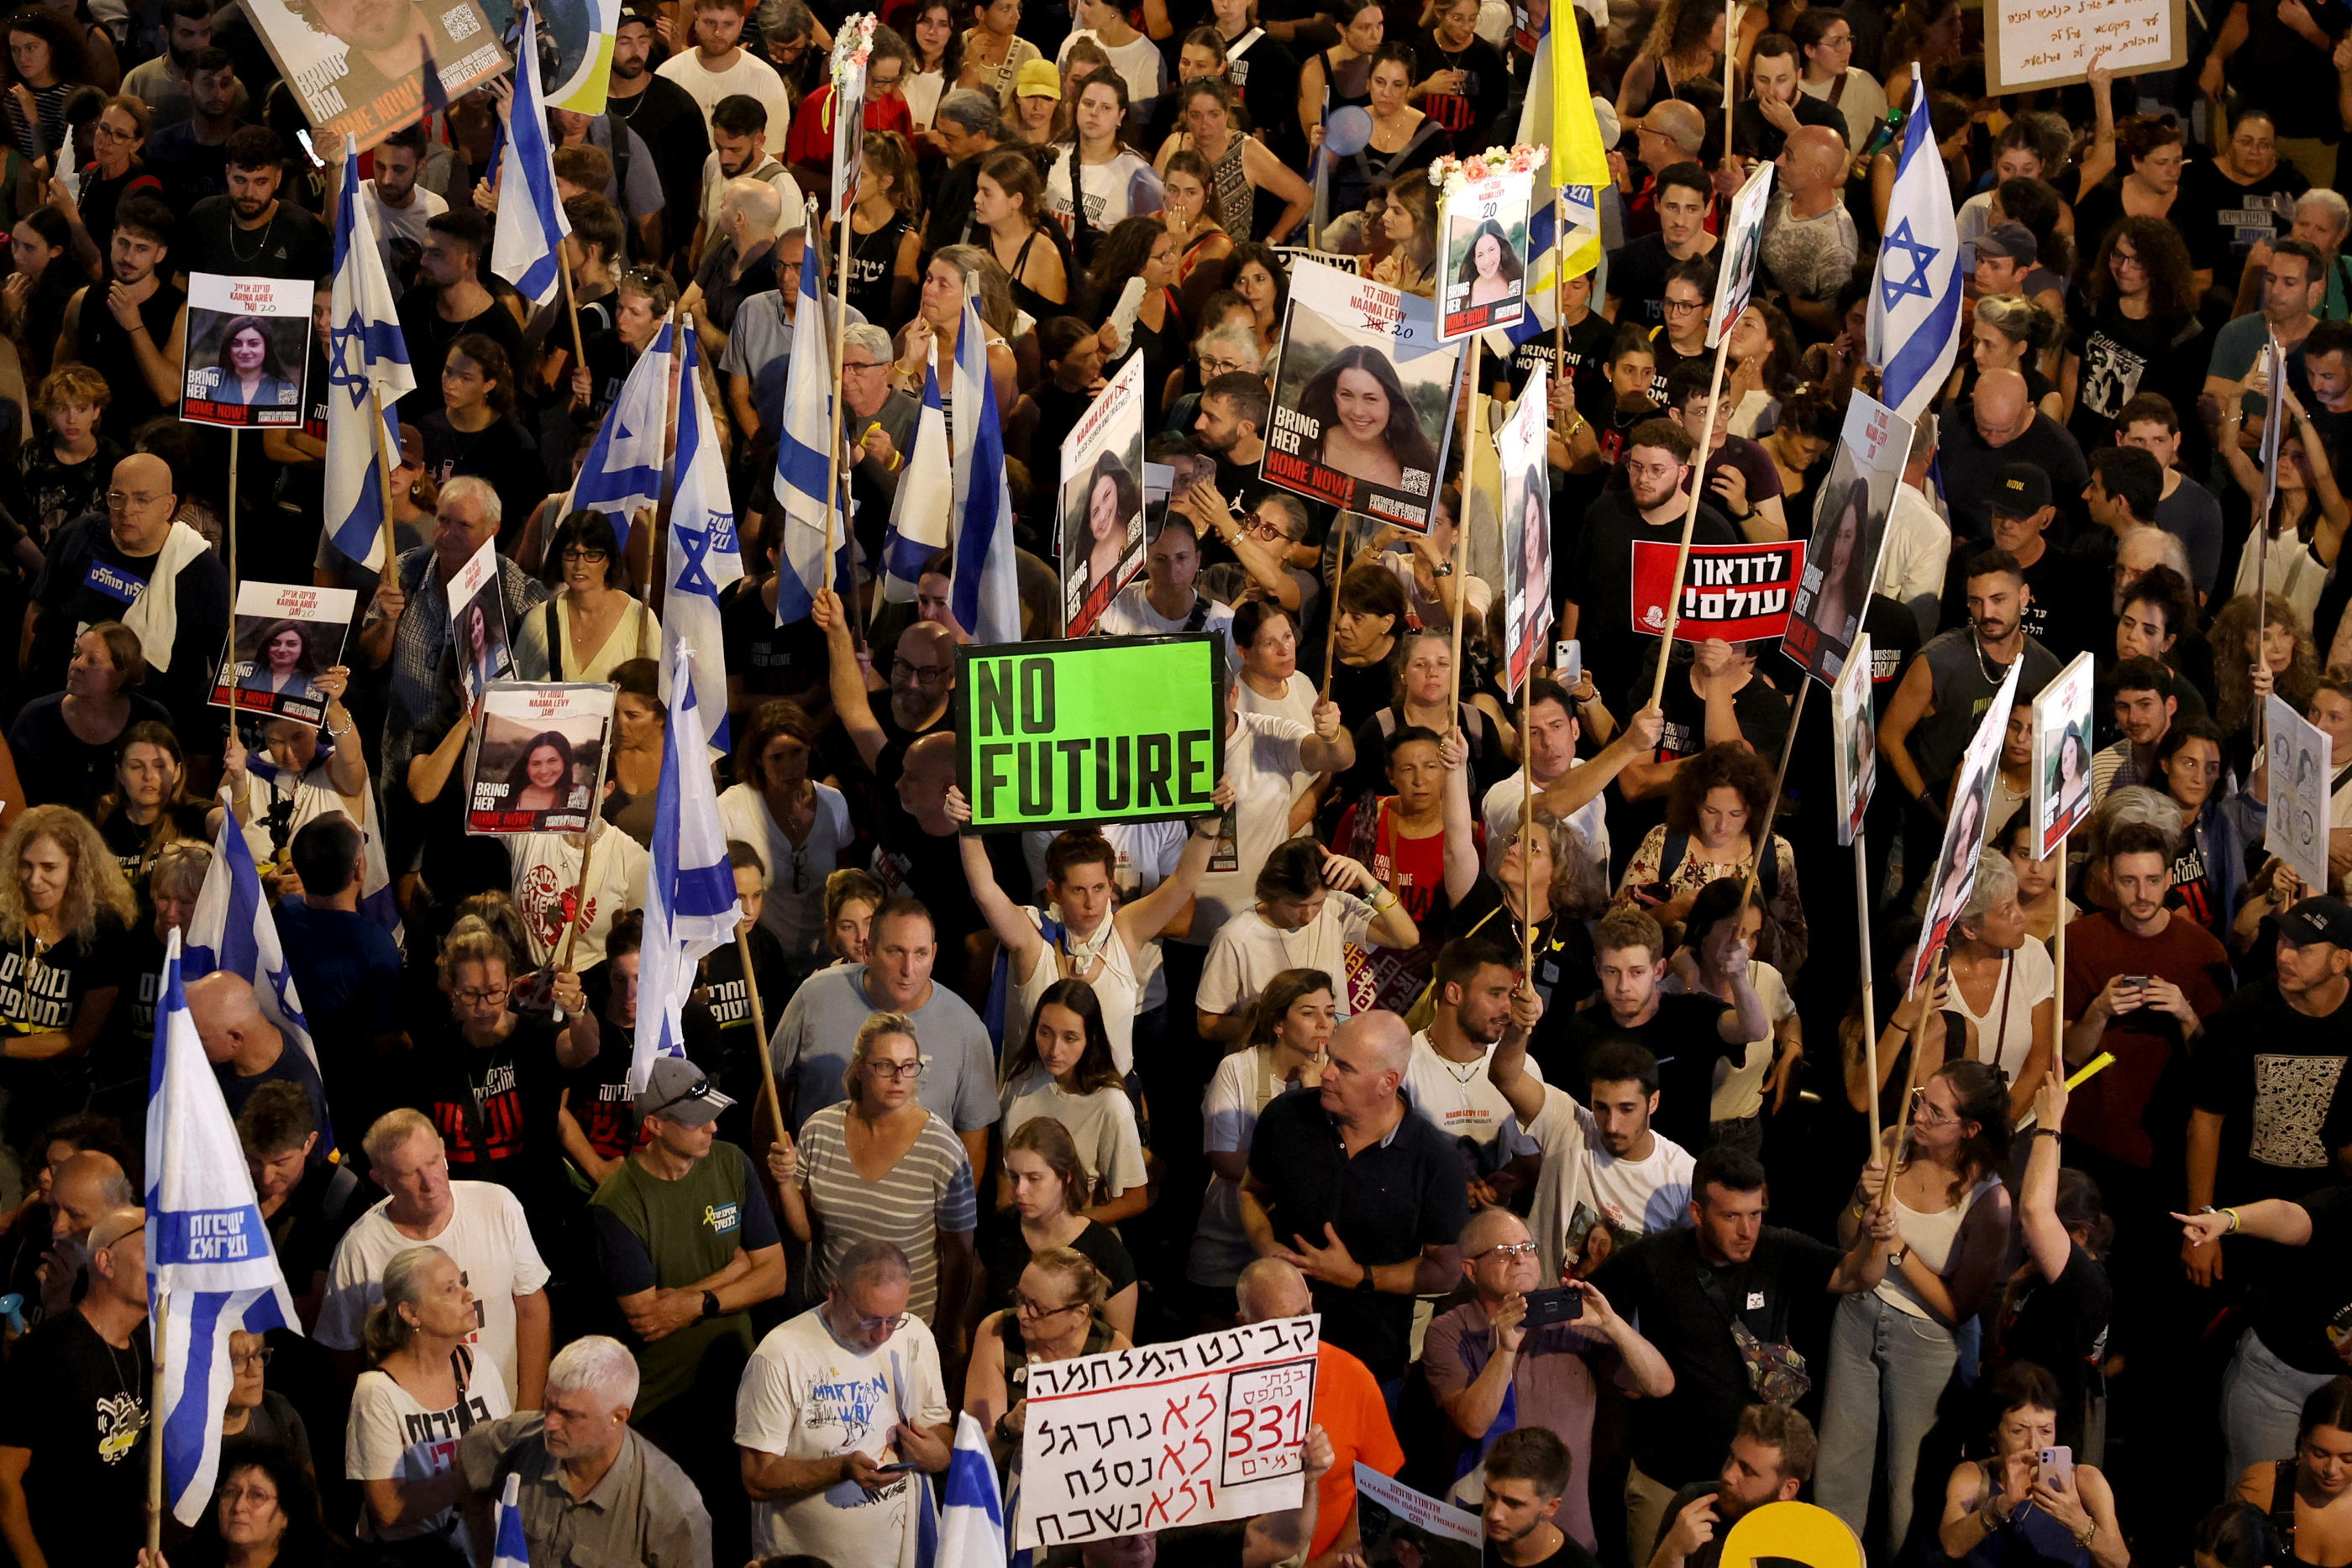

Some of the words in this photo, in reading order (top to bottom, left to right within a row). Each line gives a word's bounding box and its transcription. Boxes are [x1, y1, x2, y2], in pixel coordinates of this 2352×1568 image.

[295, 52, 349, 97] BRING
[441, 65, 477, 92] FAMILIES
[473, 50, 503, 74] FORUM
[307, 86, 348, 123] HIM
[371, 75, 425, 123] NOW!
[1482, 202, 1498, 219] 20
[230, 292, 253, 302] KARINA
[255, 294, 274, 302] ARIEV
[1362, 284, 1376, 301] לוי
[1377, 290, 1399, 307] נעמה
[1446, 281, 1470, 300] BRING
[1350, 296, 1383, 317] NAAMA
[1384, 307, 1408, 324] LEVY
[1446, 298, 1461, 314] HER
[1446, 312, 1468, 331] HOME
[1468, 307, 1489, 325] NOW!
[1391, 324, 1414, 339] 20
[1520, 343, 1557, 359] BRING
[186, 383, 207, 400] HER
[187, 370, 219, 387] BRING
[186, 400, 214, 417] HOME
[217, 403, 249, 420] NOW!
[1077, 411, 1098, 447] NAAMA
[1099, 391, 1114, 417] LEVY
[1273, 406, 1320, 440] BRING
[1271, 427, 1300, 455] HER
[1267, 450, 1310, 484] HOME
[1312, 465, 1356, 502] NOW!
[2007, 479, 2025, 491] NOW.
[1368, 501, 1400, 518] FAMILIES
[1399, 509, 1425, 525] FORUM
[91, 567, 124, 591] מוחלט
[1067, 560, 1087, 602] BRING
[1693, 553, 1782, 586] לדראון
[1800, 562, 1824, 596] BRING
[276, 598, 299, 607] KARINA
[299, 600, 318, 609] ARIEV
[1067, 590, 1081, 624] HER
[1685, 588, 1786, 619] עולם!
[1794, 590, 1811, 617] HER
[214, 688, 243, 704] HOE
[244, 690, 276, 707] NOW!
[529, 699, 553, 708] NAAMA
[554, 699, 570, 707] LEVY
[977, 658, 1056, 737] NO
[979, 729, 1211, 819] FUTURE
[472, 796, 496, 812] HER
[475, 782, 510, 798] BRING
[470, 811, 503, 826] HOME
[503, 810, 536, 826] NOW!
[1197, 1319, 1315, 1367] קבינט
[1033, 1347, 1189, 1395] המלחמה
[1162, 1382, 1217, 1436] לא
[1242, 1385, 1294, 1405] נתפס
[837, 1402, 875, 1425] WAY
[1038, 1413, 1152, 1457] נתרגל
[1229, 1398, 1304, 1458] 331
[1158, 1429, 1212, 1481] לא
[1242, 1453, 1299, 1476] ימים
[1064, 1456, 1152, 1500] נסלח
[1145, 1478, 1215, 1528] ולא
[1359, 1478, 1400, 1504] ALEXANDER
[1401, 1502, 1431, 1520] (SASHA)
[1036, 1503, 1142, 1546] נשכח
